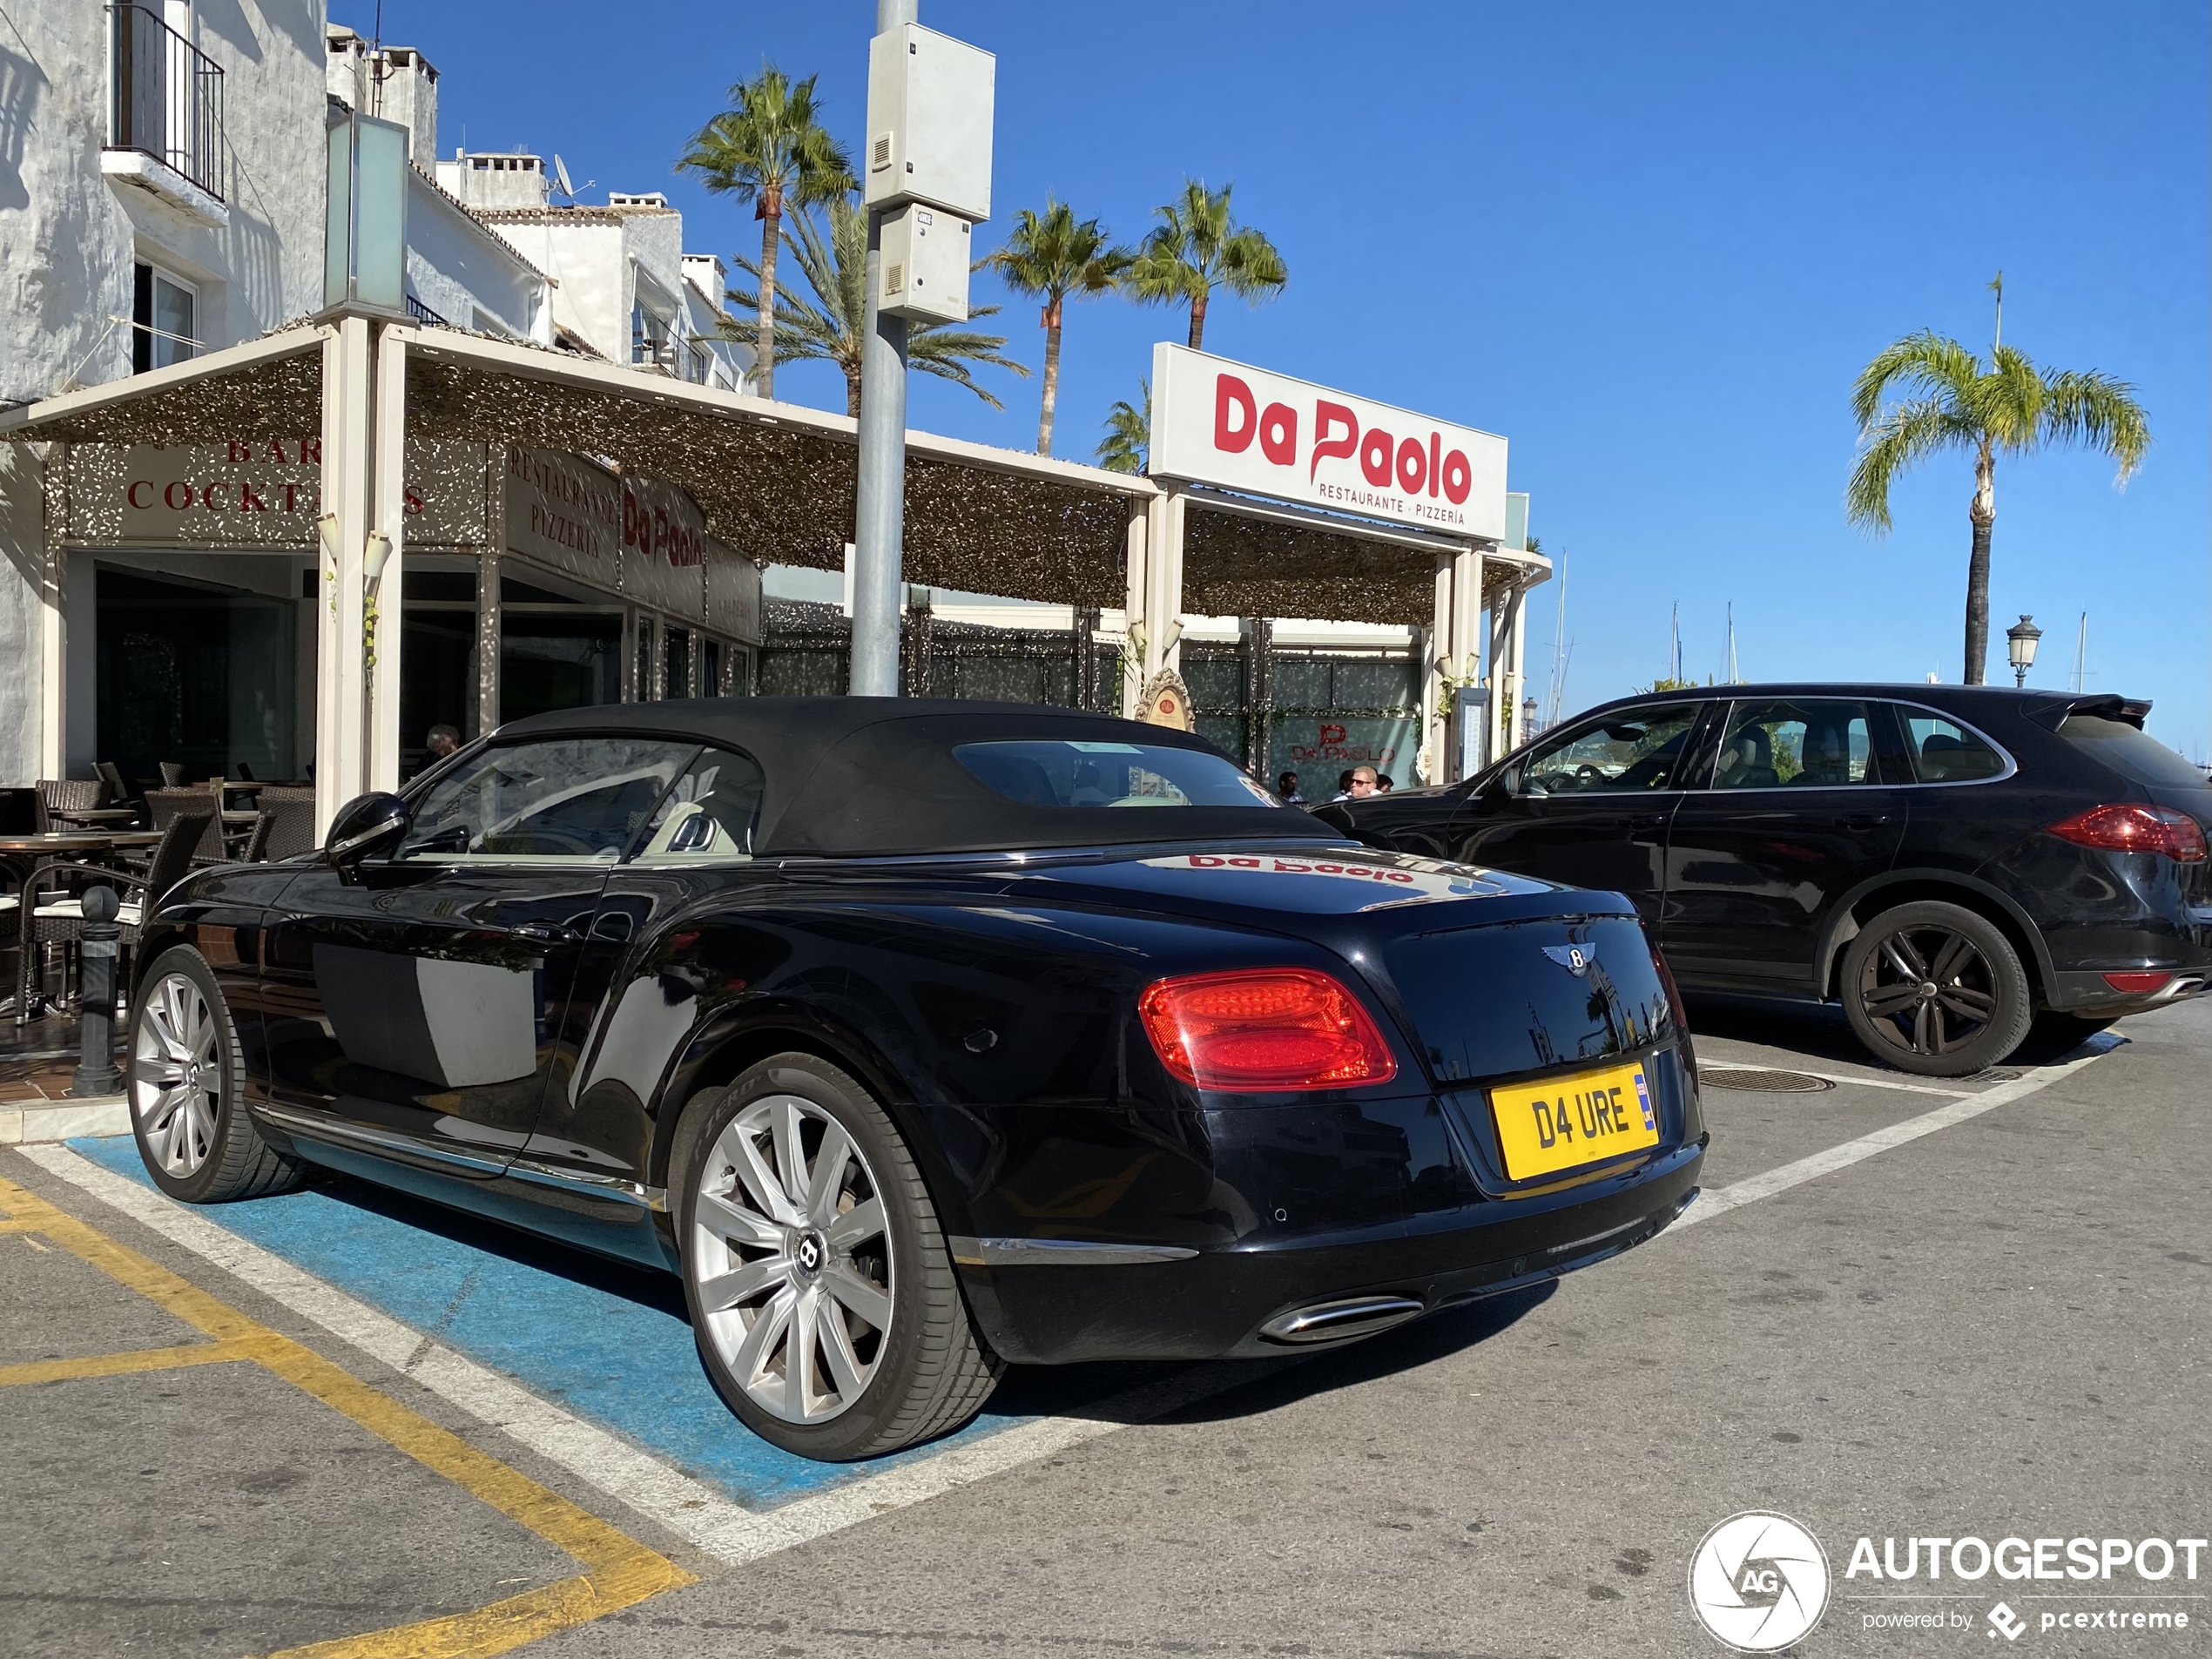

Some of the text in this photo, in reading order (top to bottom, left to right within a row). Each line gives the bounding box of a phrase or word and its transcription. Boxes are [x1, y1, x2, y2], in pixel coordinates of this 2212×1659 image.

[227, 438, 320, 463] BAR
[1214, 373, 1472, 505] Da Paolo
[511, 446, 614, 526] RESTAURANTE
[1319, 483, 1465, 525] RESTAURANTE PIZZERÍA
[531, 503, 598, 558] PIZZERIA
[624, 489, 702, 567] Da Paolo
[1292, 746, 1318, 760] DA
[1531, 1087, 1629, 1150] D4 URE
[1642, 1110, 1654, 1123] UK
